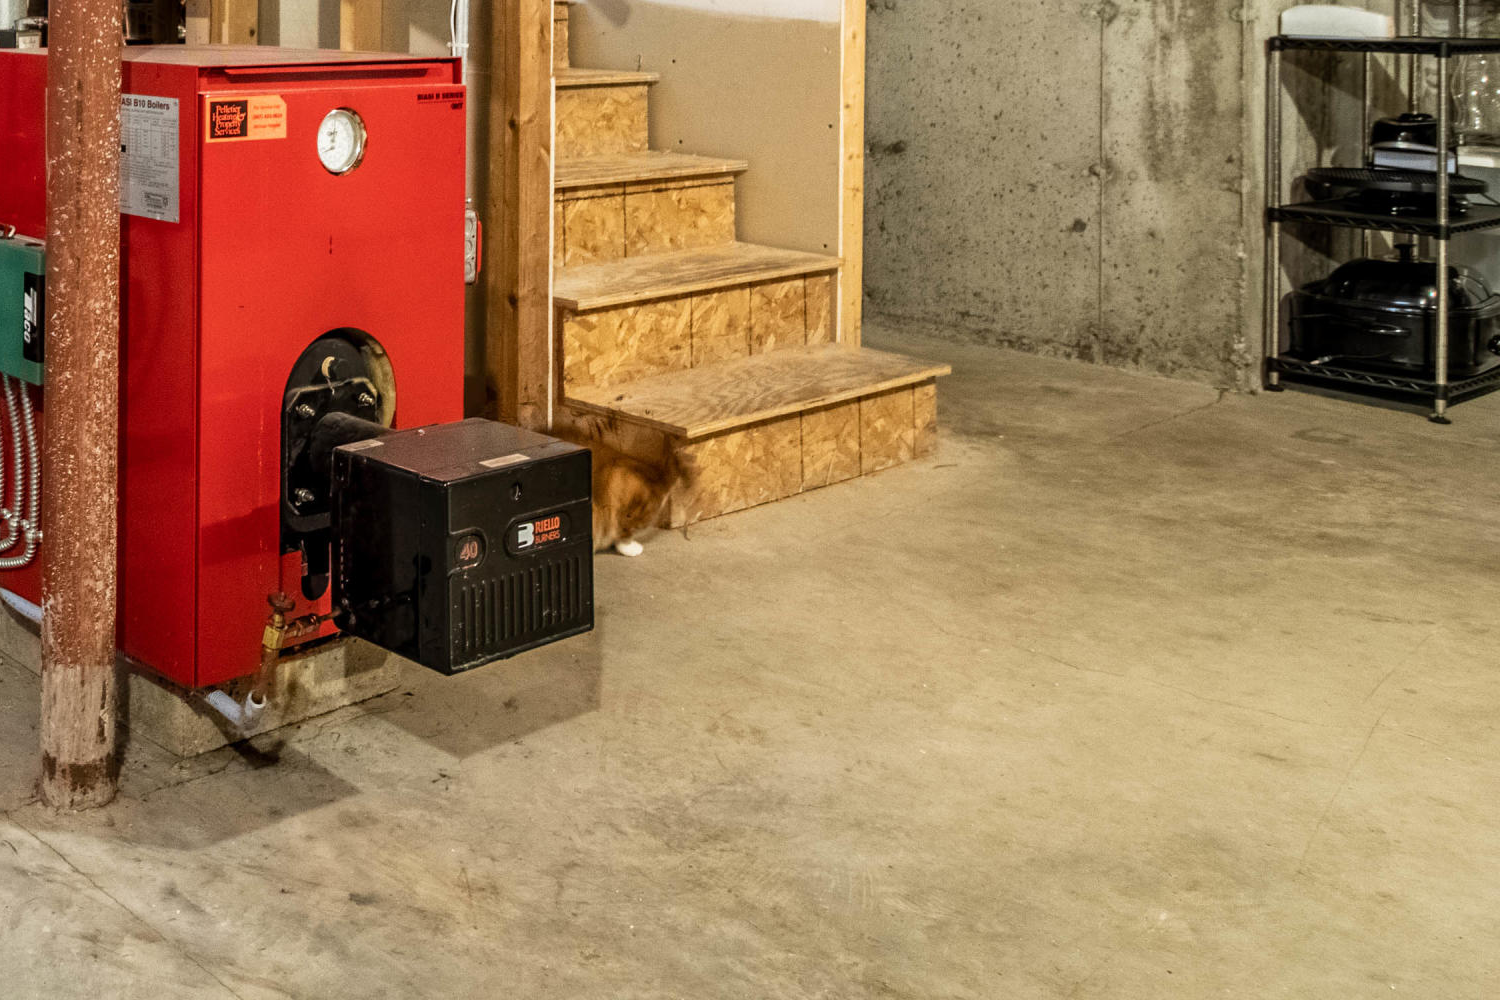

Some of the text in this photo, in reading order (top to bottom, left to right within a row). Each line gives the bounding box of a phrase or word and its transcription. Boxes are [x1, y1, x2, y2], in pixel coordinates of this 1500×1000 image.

[121, 97, 170, 111] ASI B10 Boilers
[535, 516, 560, 534] RIELLO
[460, 541, 478, 560] 40
